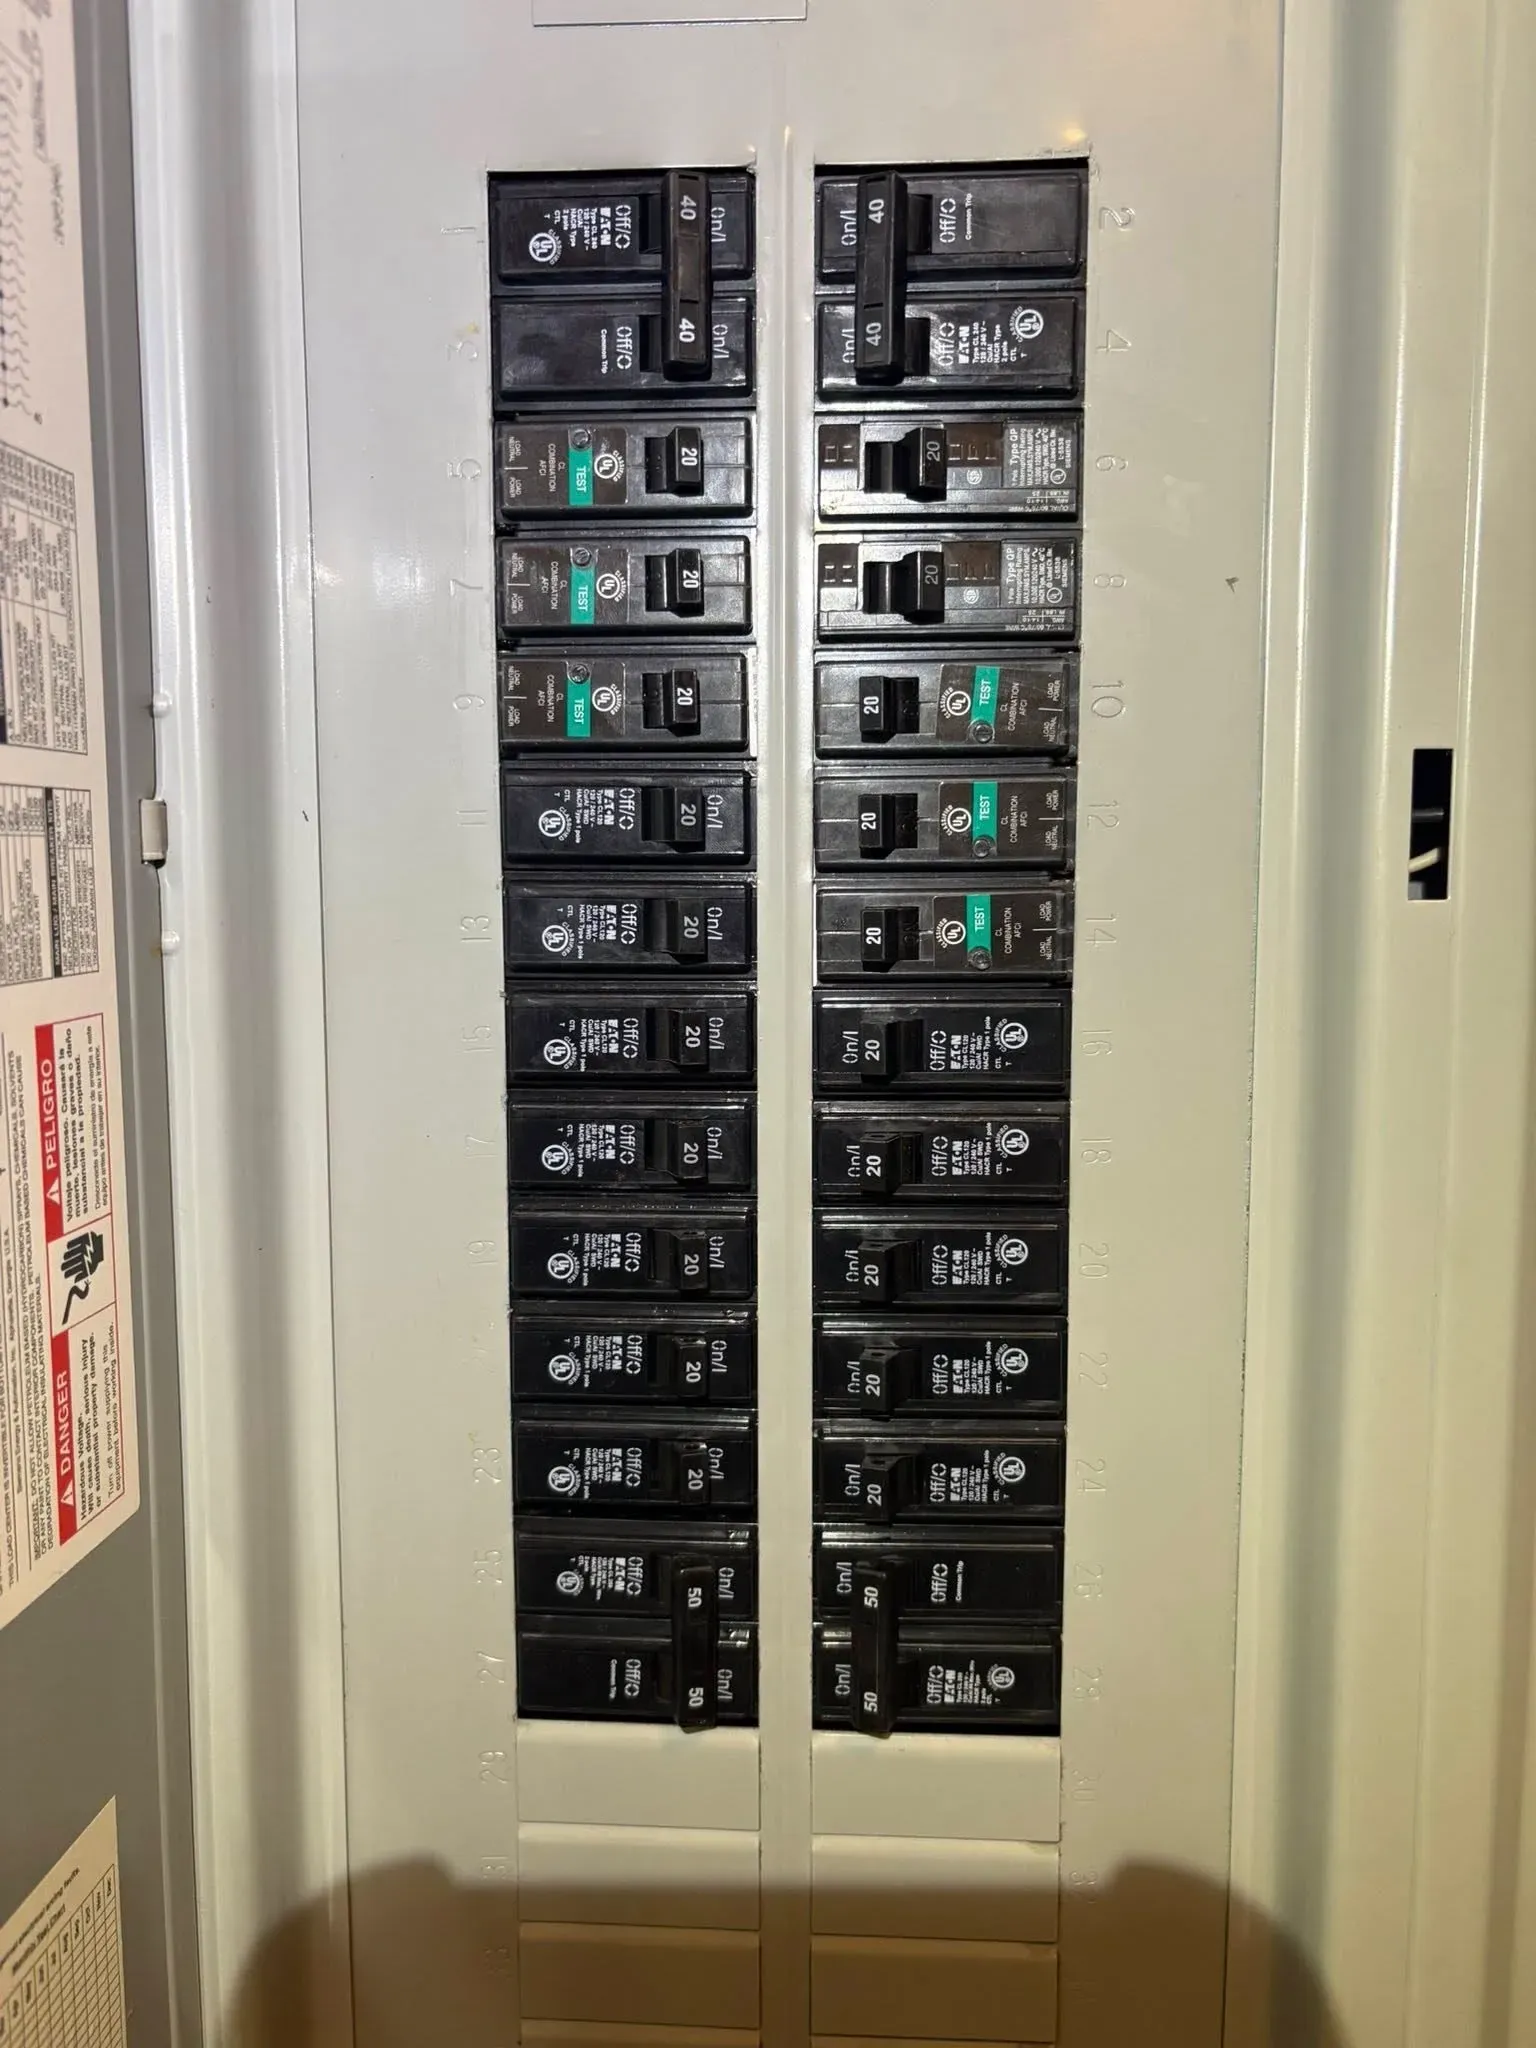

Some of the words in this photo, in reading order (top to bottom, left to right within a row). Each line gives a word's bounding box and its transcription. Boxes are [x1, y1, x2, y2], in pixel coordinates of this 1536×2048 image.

[679, 195, 696, 220] 40
[868, 199, 884, 224] 40
[1099, 206, 1136, 240] 2
[678, 318, 695, 343] 40
[866, 322, 882, 347] 40
[1095, 328, 1132, 354] 4
[682, 448, 697, 466] 20
[927, 441, 941, 462] 20
[1096, 454, 1129, 472] 6
[548, 443, 556, 492] COMBINATION
[576, 465, 587, 493] TEST
[541, 577, 549, 594] AFCI
[551, 561, 559, 610] COMBINATION
[684, 570, 699, 589] 20
[925, 564, 938, 585] 20
[1093, 573, 1127, 589] 8
[450, 579, 484, 598] 7
[578, 585, 589, 612] TEST
[453, 694, 485, 710] 9
[547, 674, 555, 723] COMBINATION
[678, 687, 692, 706] 20
[979, 679, 990, 705] TEST
[1091, 682, 1126, 718] 10
[574, 698, 583, 724] TEST
[864, 696, 879, 715] 20
[1008, 682, 1019, 732] COMBINATION
[1019, 699, 1027, 716] AFCI
[457, 809, 488, 826] 11
[681, 804, 696, 826] 20
[980, 795, 990, 820] TEST
[1010, 795, 1018, 843] COMBINATION
[1087, 799, 1120, 830] 12
[861, 812, 876, 830] 20
[460, 915, 493, 942] 13
[684, 917, 699, 939] 20
[975, 906, 984, 932] TEST
[1014, 922, 1022, 938] AFCI
[1085, 913, 1118, 947] 14
[866, 927, 882, 945] 20
[461, 1025, 494, 1052] 15
[685, 1026, 701, 1049] 20
[1081, 1028, 1112, 1057] 16
[865, 1039, 880, 1062] 20
[41, 1059, 57, 1171] PELIGRO
[464, 1134, 497, 1158] 17
[684, 1142, 699, 1164] 20
[1081, 1137, 1112, 1165] 18
[866, 1155, 881, 1177] 20
[467, 1240, 498, 1266] 19
[684, 1255, 699, 1276] 20
[1078, 1243, 1110, 1279] 20
[864, 1264, 879, 1286] 20
[686, 1362, 701, 1383] 20
[1078, 1351, 1108, 1388] 22
[103, 1367, 111, 1416] supplying
[866, 1374, 880, 1396] 20
[91, 1383, 99, 1429] property
[57, 1370, 71, 1476] DANGER
[93, 1432, 101, 1492] substantial
[472, 1448, 502, 1484] 23
[688, 1469, 703, 1490] 20
[1075, 1457, 1107, 1495] 24
[96, 1496, 101, 1507] or
[868, 1484, 881, 1506] 20
[473, 1550, 503, 1584] 25
[688, 1587, 702, 1608] 50
[864, 1586, 879, 1608] 50
[689, 1687, 703, 1708] 50
[864, 1691, 878, 1712] 50
